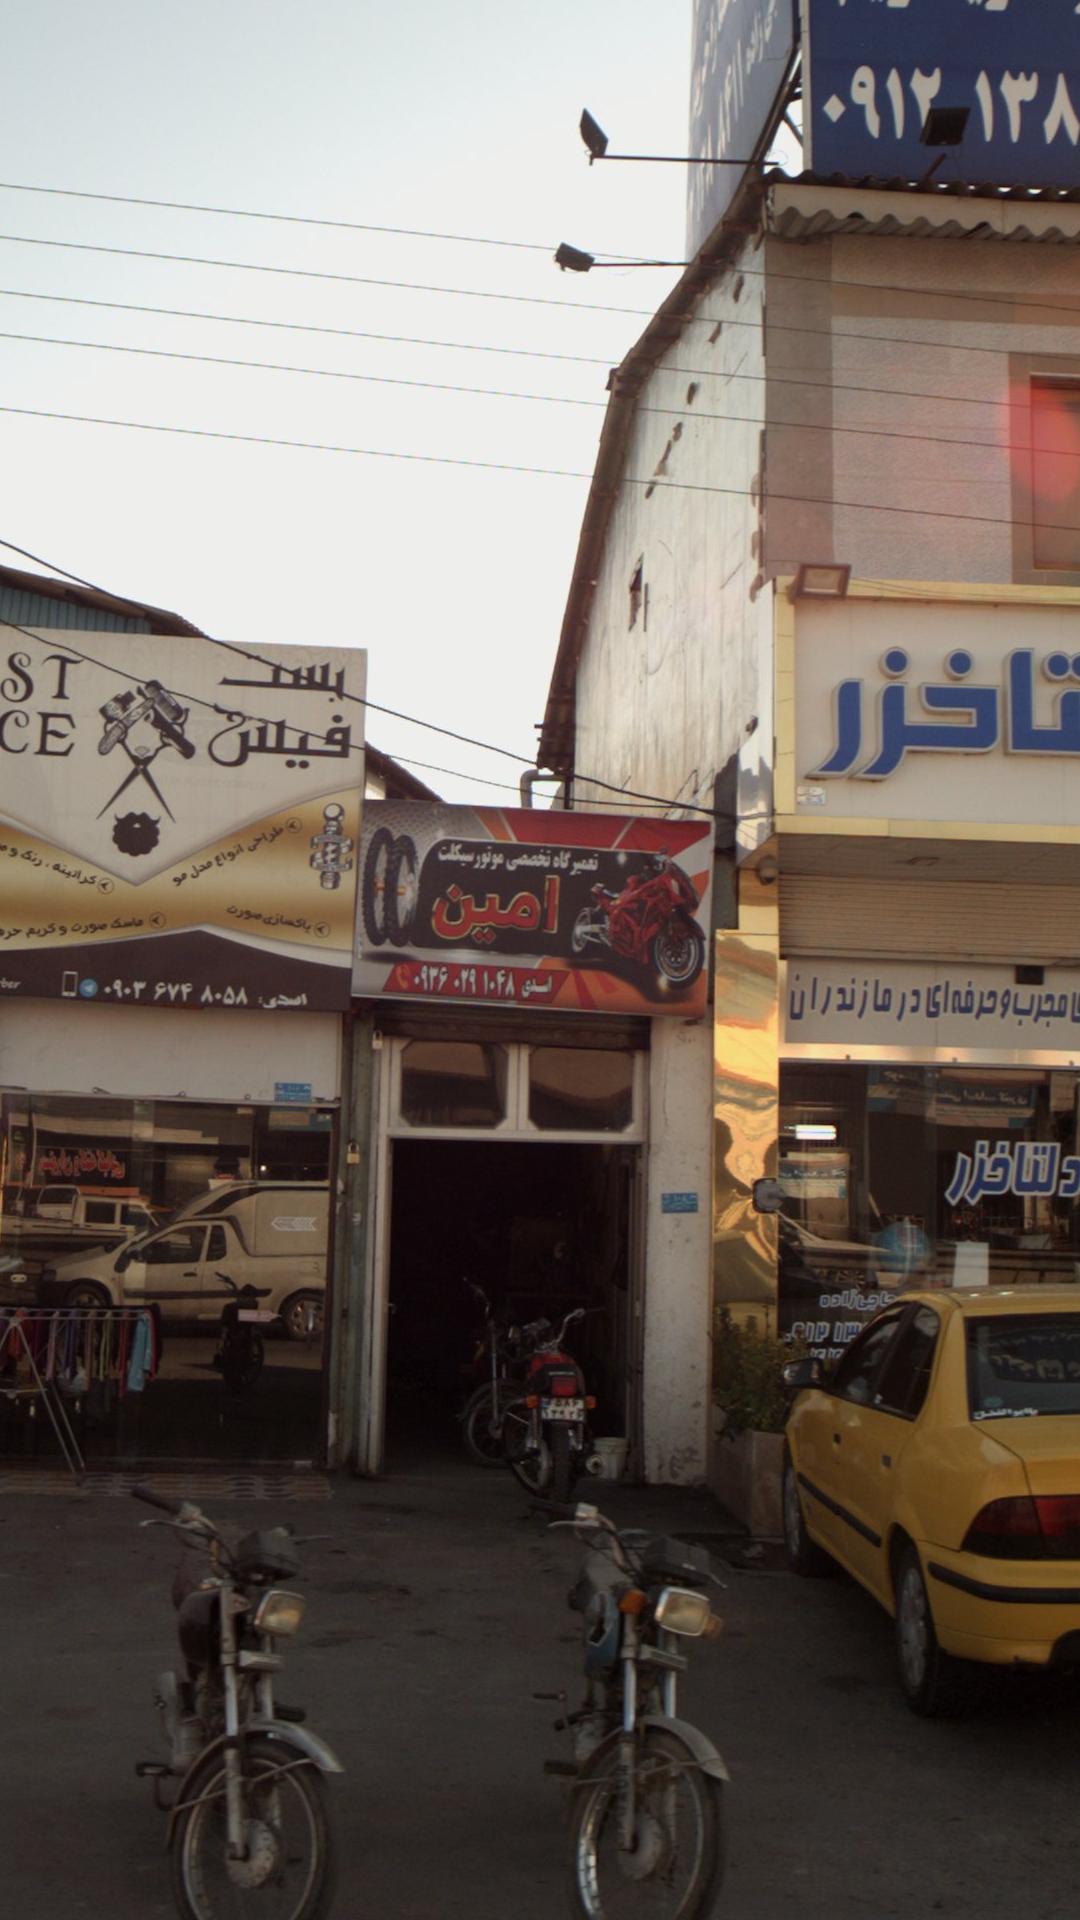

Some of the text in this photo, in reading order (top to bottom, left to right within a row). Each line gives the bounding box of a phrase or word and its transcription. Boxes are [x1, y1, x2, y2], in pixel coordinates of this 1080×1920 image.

[214, 844, 244, 867] انواع
[506, 849, 551, 871] تخصصی
[172, 872, 187, 887] مو
[432, 875, 560, 944] امین
[71, 921, 107, 934] صورت
[110, 917, 144, 929] ماسک
[104, 979, 146, 999] ۰۹۰۳
[154, 982, 193, 1000] ۶۷۴
[201, 985, 248, 1005] ۸۰۵۸
